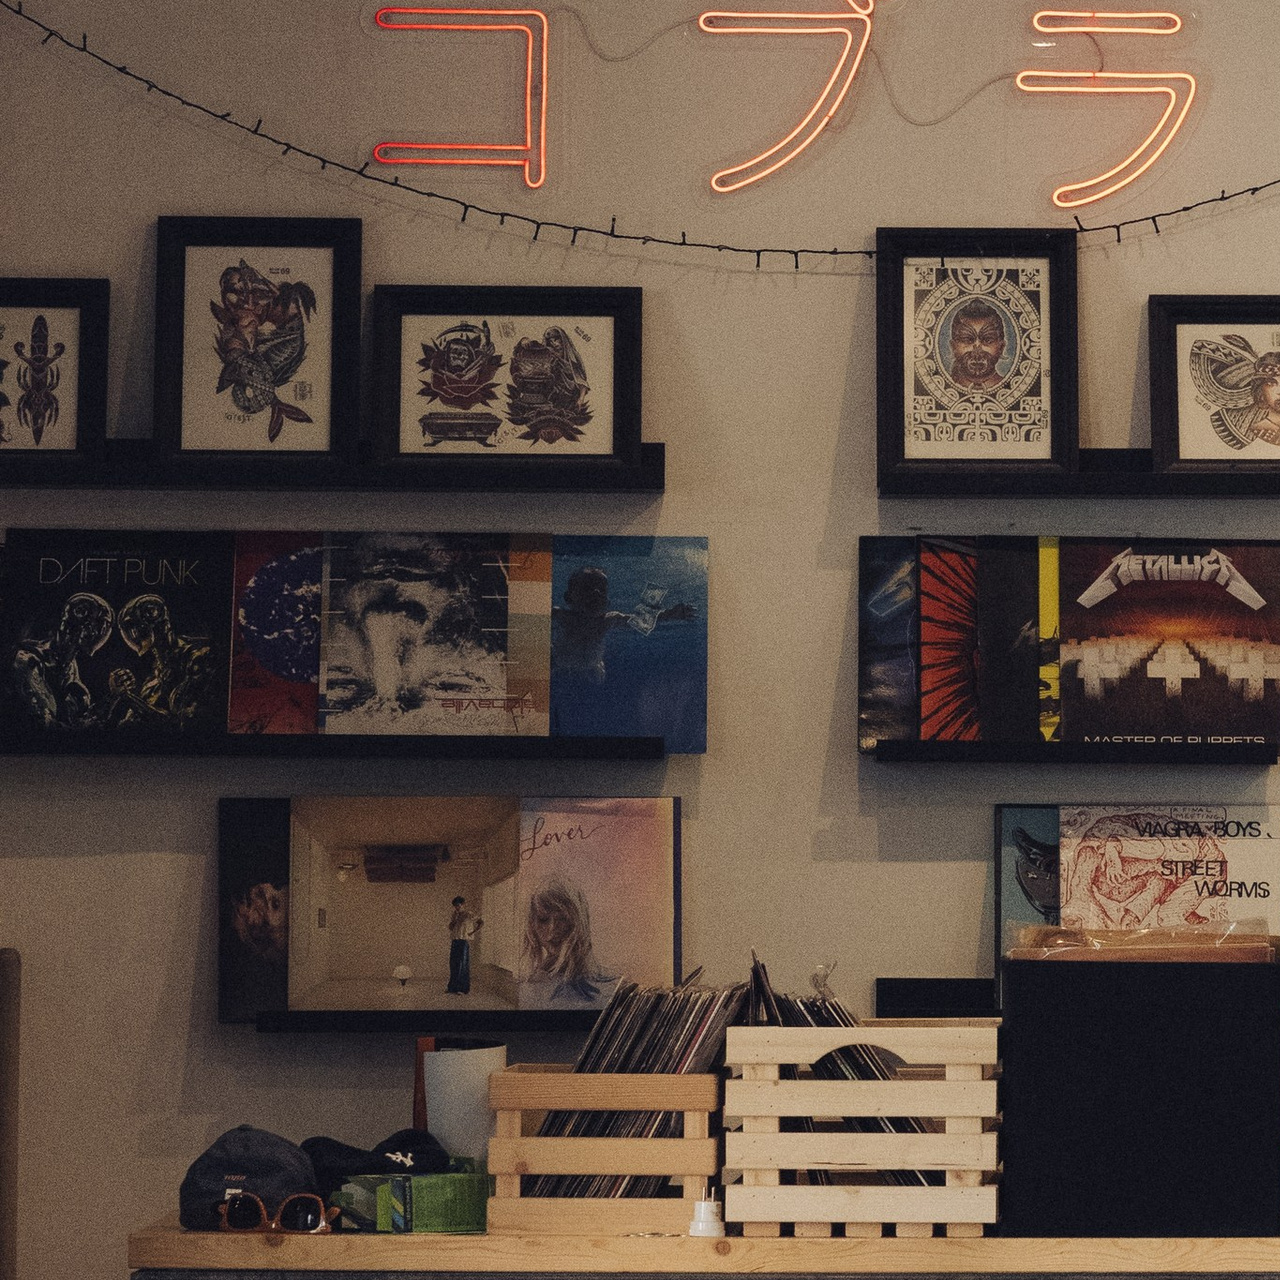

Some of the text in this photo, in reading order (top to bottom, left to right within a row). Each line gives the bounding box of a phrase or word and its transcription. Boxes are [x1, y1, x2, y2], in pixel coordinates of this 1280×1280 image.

[39, 557, 200, 585] DAFT PUNK
[1076, 547, 1267, 610] METALLICA
[519, 816, 604, 861] Lover
[1135, 820, 1261, 837] VIAGRA BOYS
[1161, 859, 1228, 878] STREET
[1194, 880, 1270, 898] WORMS
